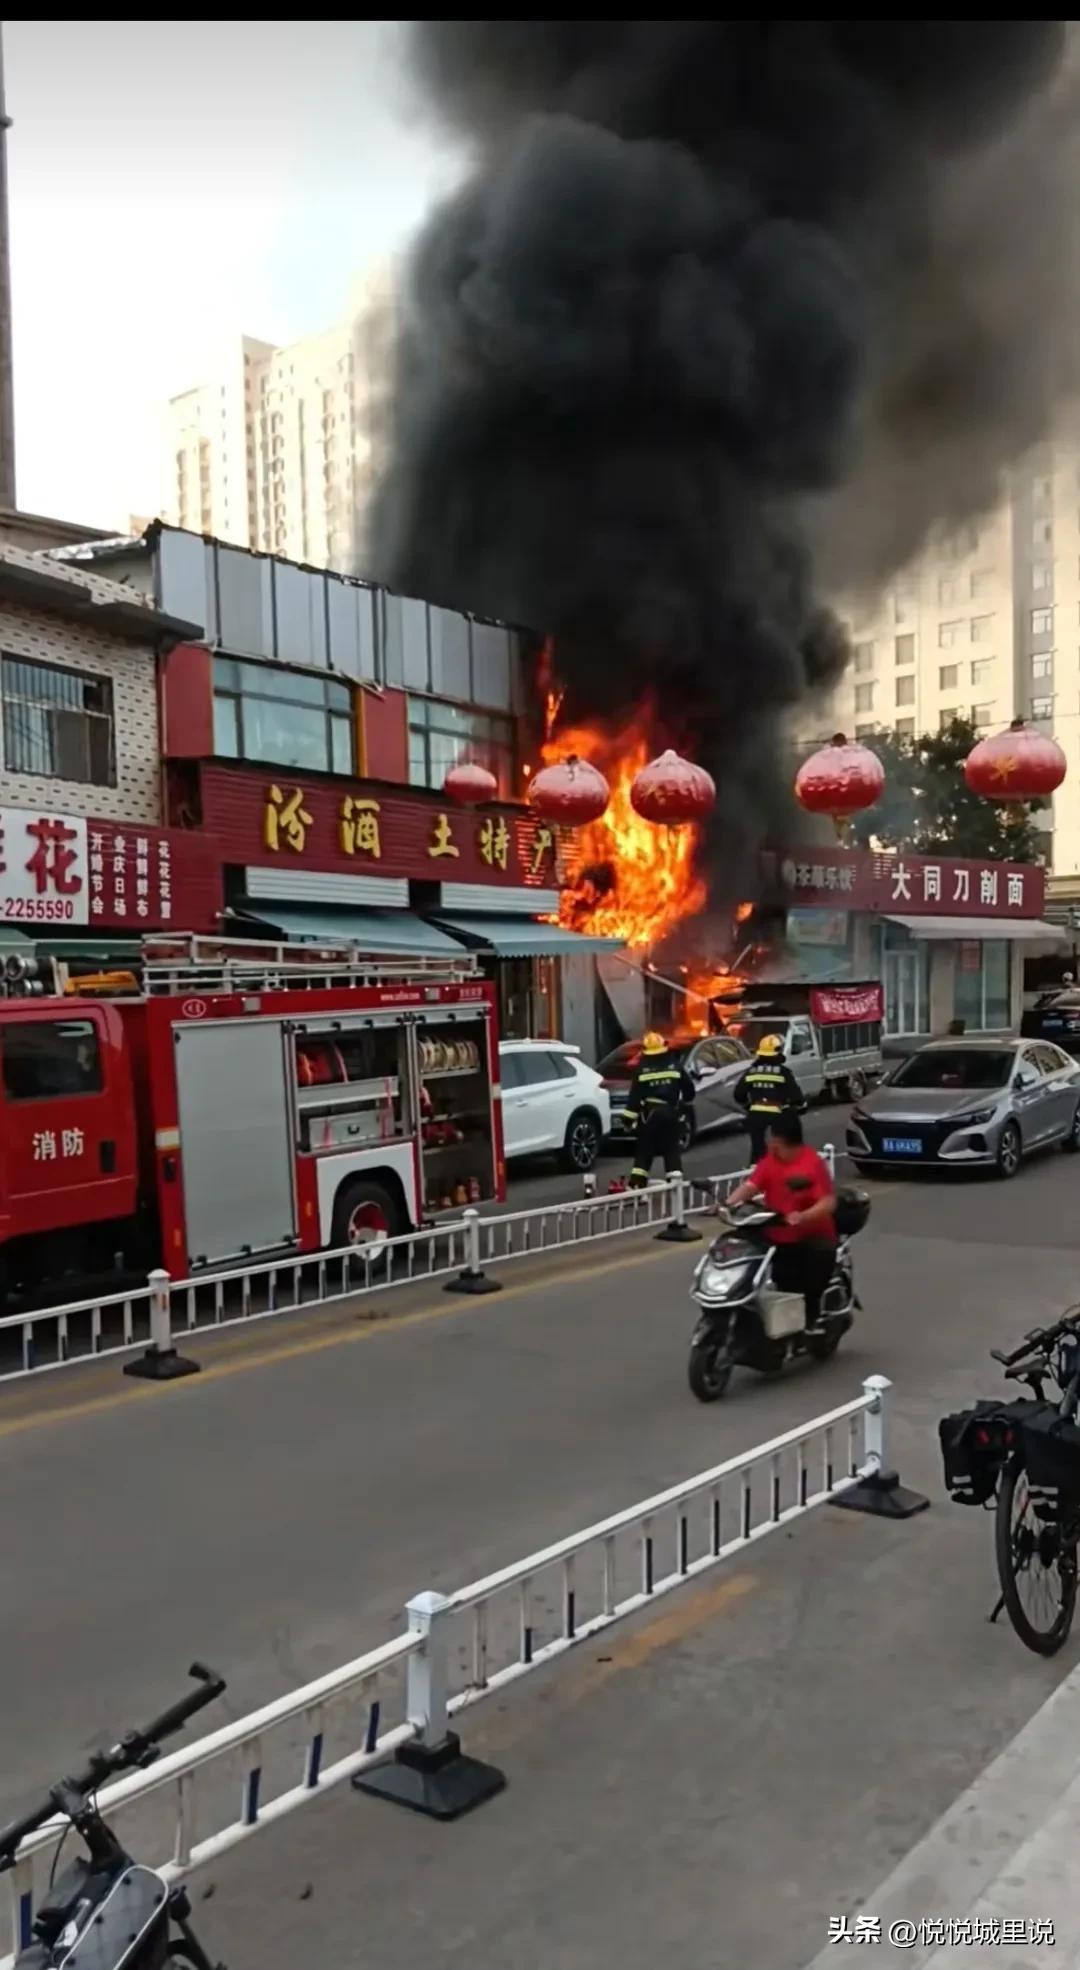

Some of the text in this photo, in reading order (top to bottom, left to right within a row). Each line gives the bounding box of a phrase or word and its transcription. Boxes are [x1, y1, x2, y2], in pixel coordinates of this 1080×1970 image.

[0, 815, 82, 895] 花
[891, 862, 1024, 907] 大同刀削面
[32, 1127, 84, 1160] 消防
